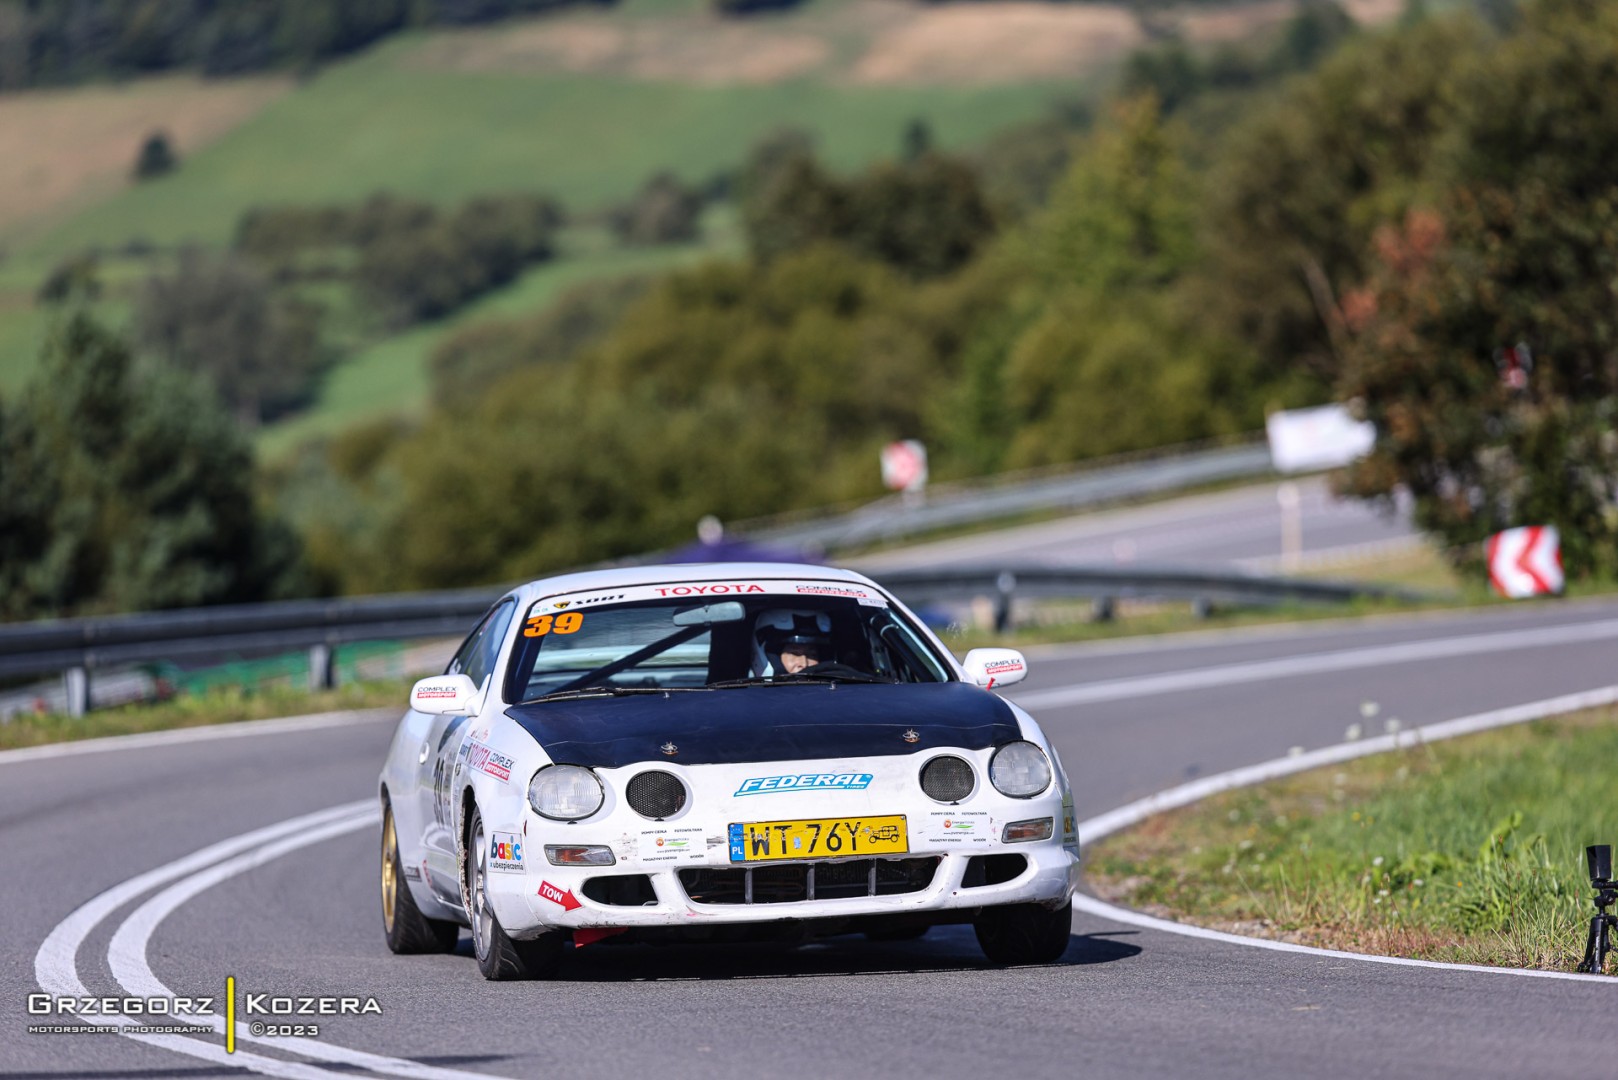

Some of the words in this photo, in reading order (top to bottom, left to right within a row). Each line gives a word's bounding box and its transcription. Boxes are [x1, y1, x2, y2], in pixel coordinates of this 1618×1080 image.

[655, 585, 765, 597] TOYOTA
[796, 584, 864, 593] COMPLEX
[523, 612, 584, 637] 39
[985, 659, 1021, 668] COMPLEX
[489, 752, 515, 770] COMPLEX
[741, 774, 868, 791] FEDERAL
[490, 834, 522, 861] basic
[750, 825, 792, 856] WT
[806, 822, 861, 853] 76Y
[732, 846, 743, 855] PL
[493, 861, 524, 871] ubezpieczenia
[542, 885, 564, 903] TOW
